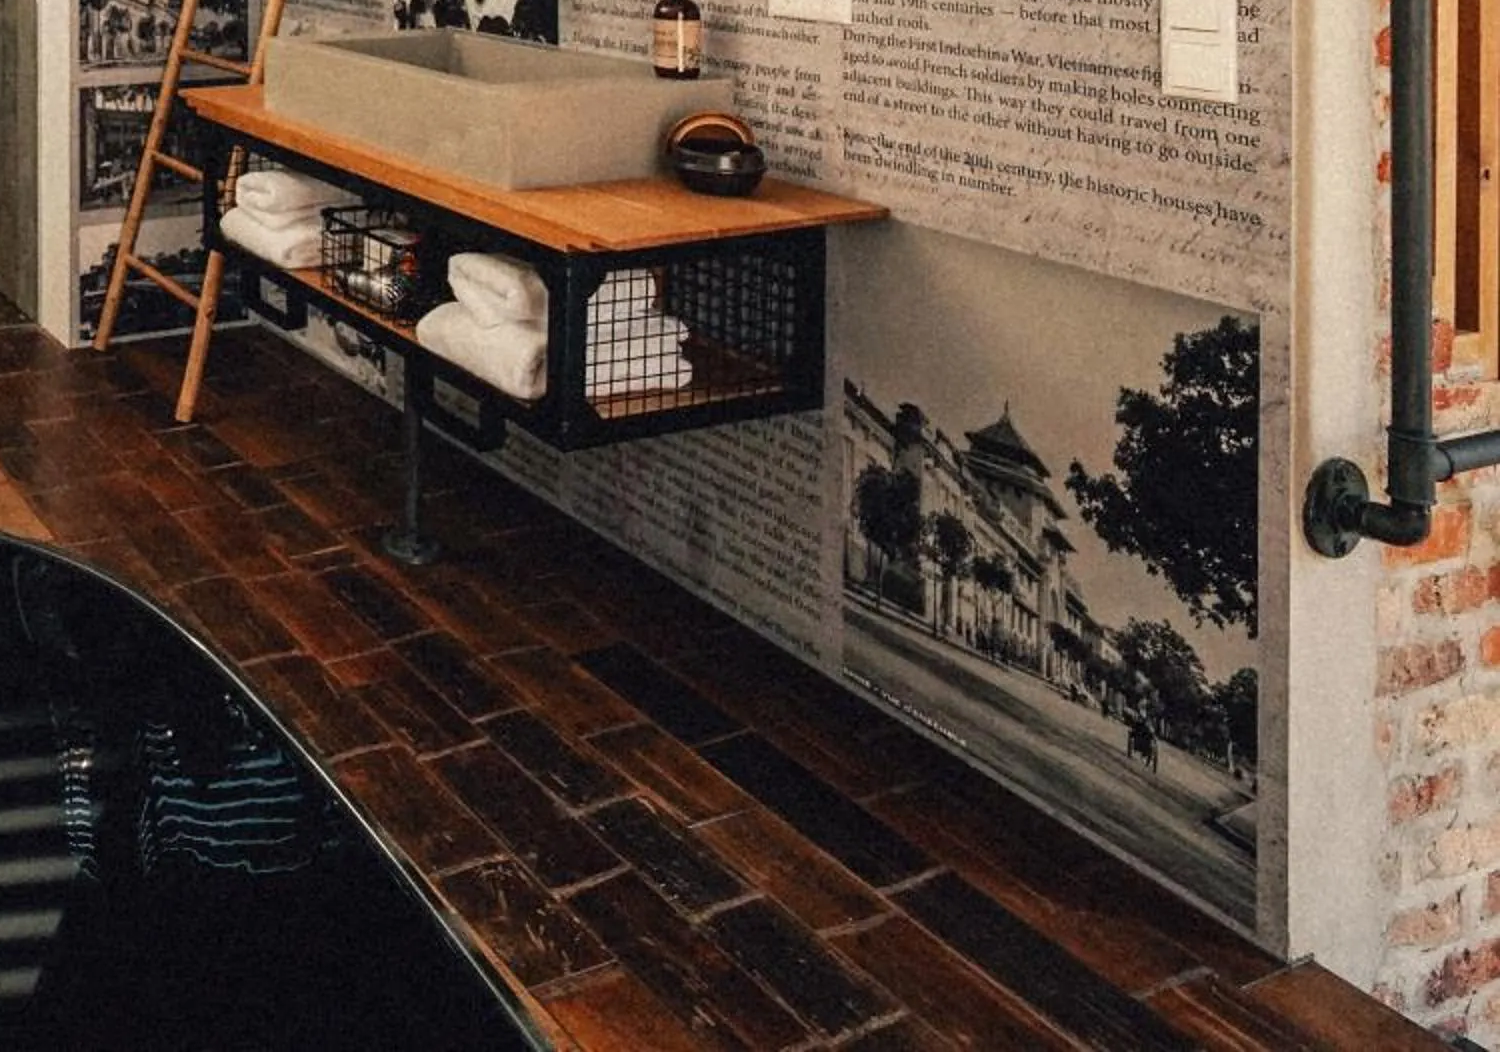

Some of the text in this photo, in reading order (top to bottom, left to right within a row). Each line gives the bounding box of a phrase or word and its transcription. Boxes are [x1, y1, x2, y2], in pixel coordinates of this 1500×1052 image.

[931, 0, 993, 16] centuries
[1019, 4, 1068, 24] before
[1072, 10, 1102, 27] that
[1109, 16, 1151, 32] most
[923, 59, 1261, 127] French soldiers by making holes connecting
[1046, 53, 1140, 79] Vietnamese
[843, 89, 864, 103] end
[893, 98, 927, 114] street
[931, 103, 945, 117] to
[947, 105, 968, 122] the
[972, 111, 1010, 129] other
[1014, 119, 1072, 140] without
[1076, 126, 1130, 155] having
[1136, 138, 1155, 155] to
[1157, 144, 1179, 162] go
[963, 86, 1260, 148] This way they could travel from one
[940, 147, 1260, 226] the the historic houses have
[941, 168, 954, 183] in
